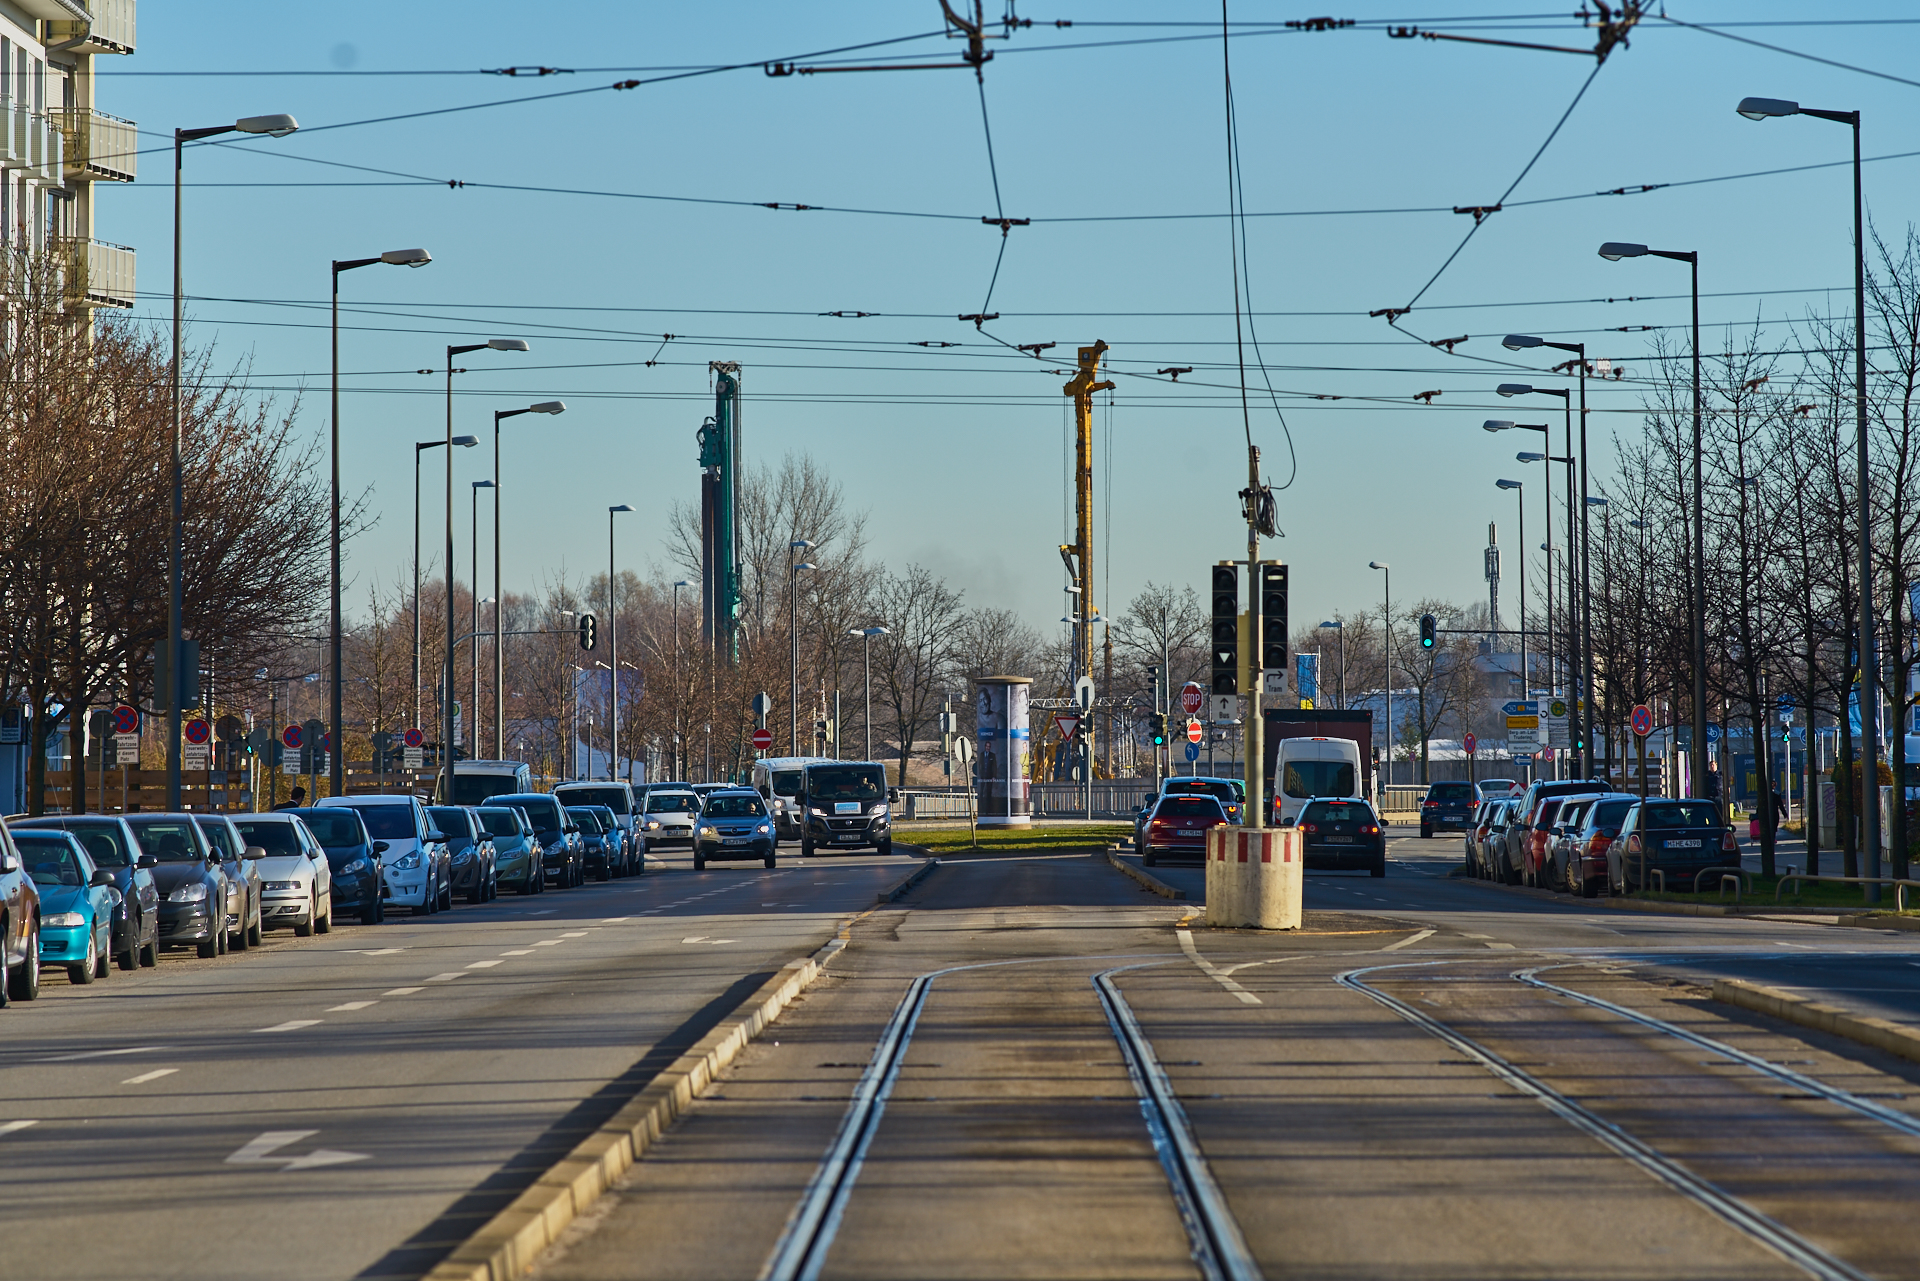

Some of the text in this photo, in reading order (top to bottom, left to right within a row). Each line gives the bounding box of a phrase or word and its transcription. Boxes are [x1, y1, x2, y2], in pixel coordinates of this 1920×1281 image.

[1268, 685, 1283, 693] Tram
[1183, 693, 1201, 706] STOP
[1219, 711, 1230, 719] Bus
